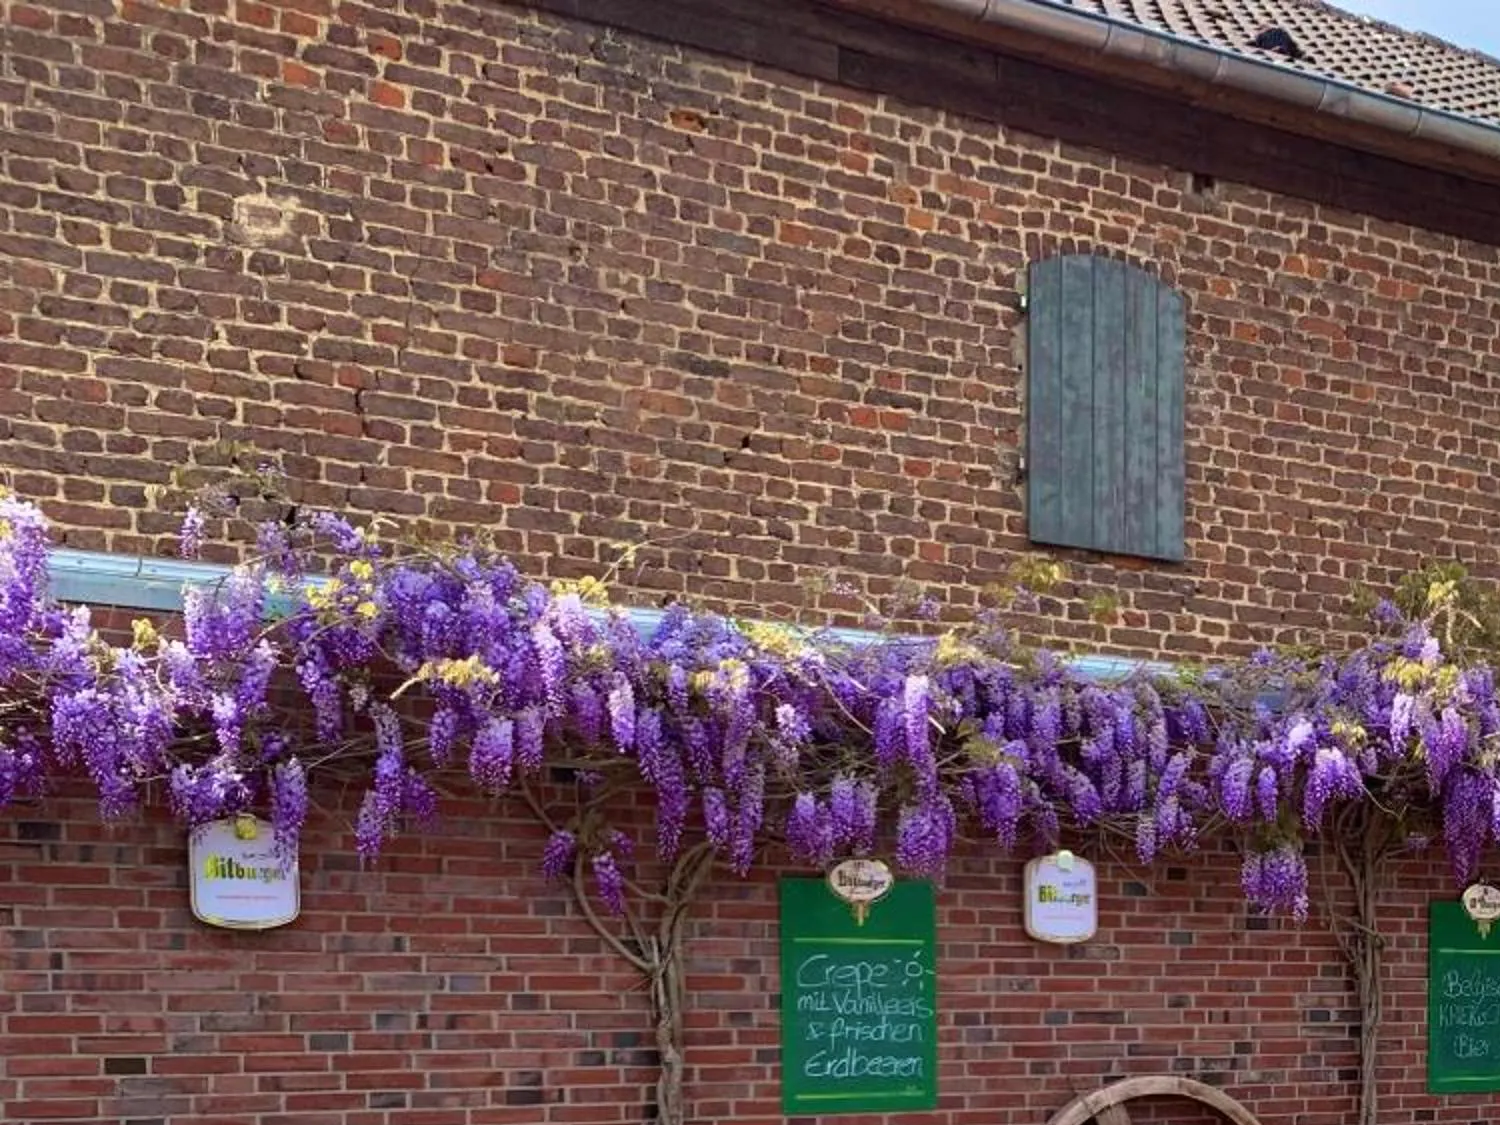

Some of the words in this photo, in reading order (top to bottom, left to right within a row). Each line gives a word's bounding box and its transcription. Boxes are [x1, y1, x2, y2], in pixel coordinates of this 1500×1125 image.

[797, 991, 831, 1011] mit
[829, 1016, 923, 1050] frischen
[804, 1046, 923, 1077] Erdbeeren
